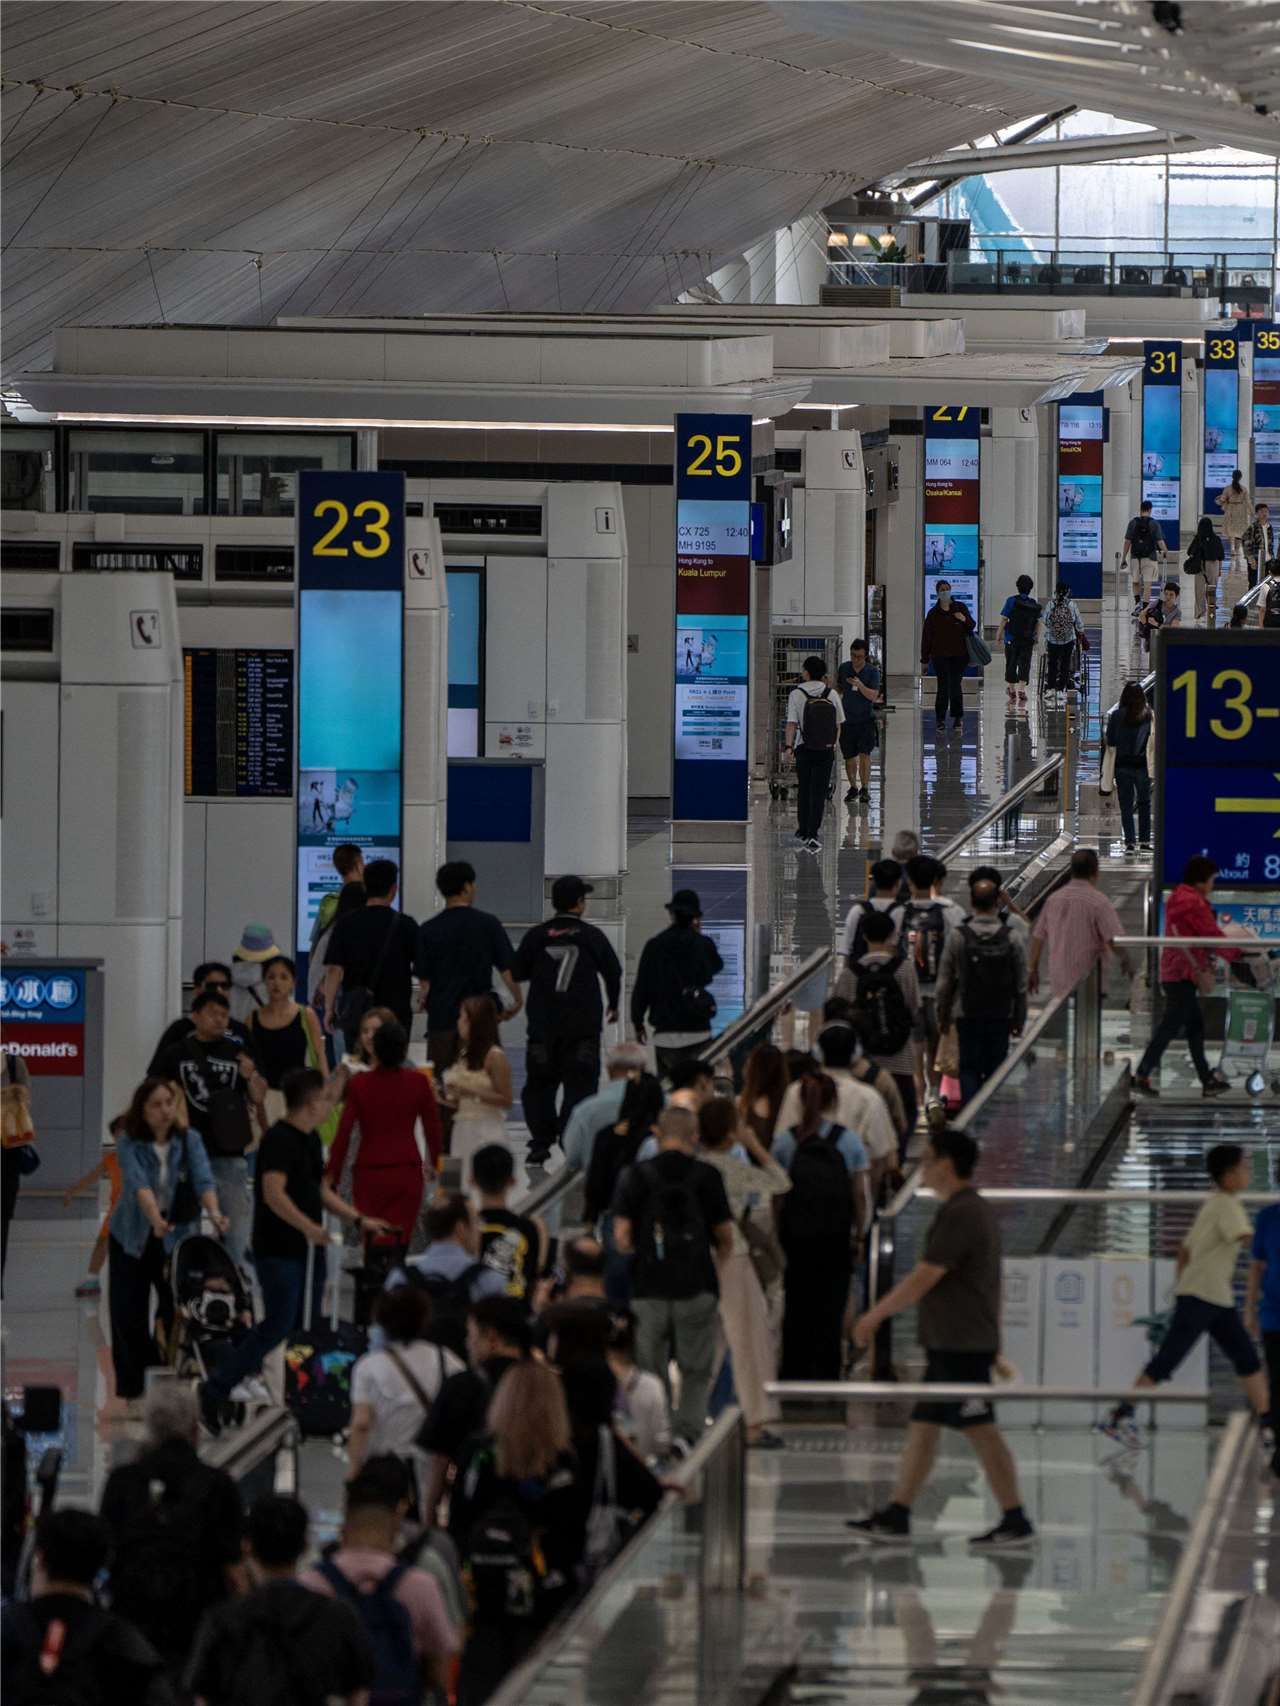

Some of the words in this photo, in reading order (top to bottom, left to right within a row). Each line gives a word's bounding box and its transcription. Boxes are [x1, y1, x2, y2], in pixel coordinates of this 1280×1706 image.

[1209, 339, 1235, 359] 33
[1257, 331, 1280, 349] 35
[1150, 351, 1176, 374] 31
[686, 435, 742, 477] 25
[311, 499, 391, 557] 23
[679, 527, 692, 536] CX
[694, 527, 710, 536] 725
[726, 527, 748, 537] 12:40
[679, 541, 693, 550] MH
[695, 541, 716, 551] 9195
[678, 568, 698, 577] Kuala
[700, 568, 726, 578] Lumpur
[1217, 868, 1249, 880] About
[1236, 853, 1250, 867] 約
[1264, 855, 1280, 879] 8
[545, 945, 579, 992] 7
[0, 1041, 78, 1057] cDonald's
